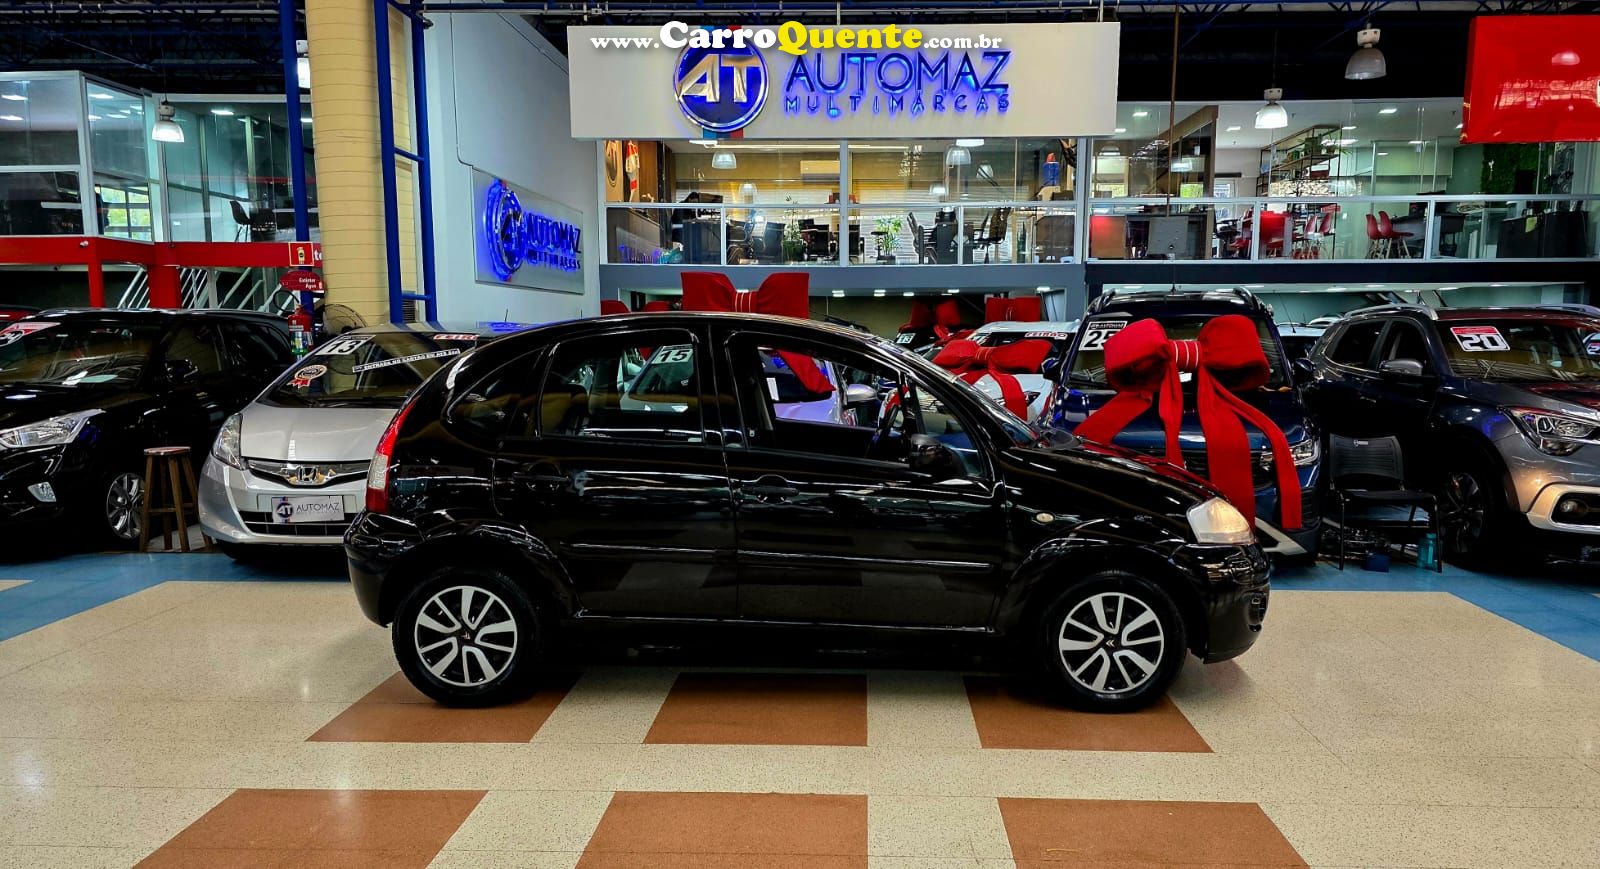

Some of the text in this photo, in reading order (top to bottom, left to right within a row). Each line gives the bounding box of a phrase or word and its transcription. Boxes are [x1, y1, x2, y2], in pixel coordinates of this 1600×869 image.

[677, 53, 763, 103] AT
[785, 50, 1012, 93] AUTOMAZ
[785, 94, 1010, 113] MULTIMARCAS
[327, 340, 362, 353] 13
[660, 350, 691, 362] 15
[296, 502, 340, 512] AUTOMAZ
